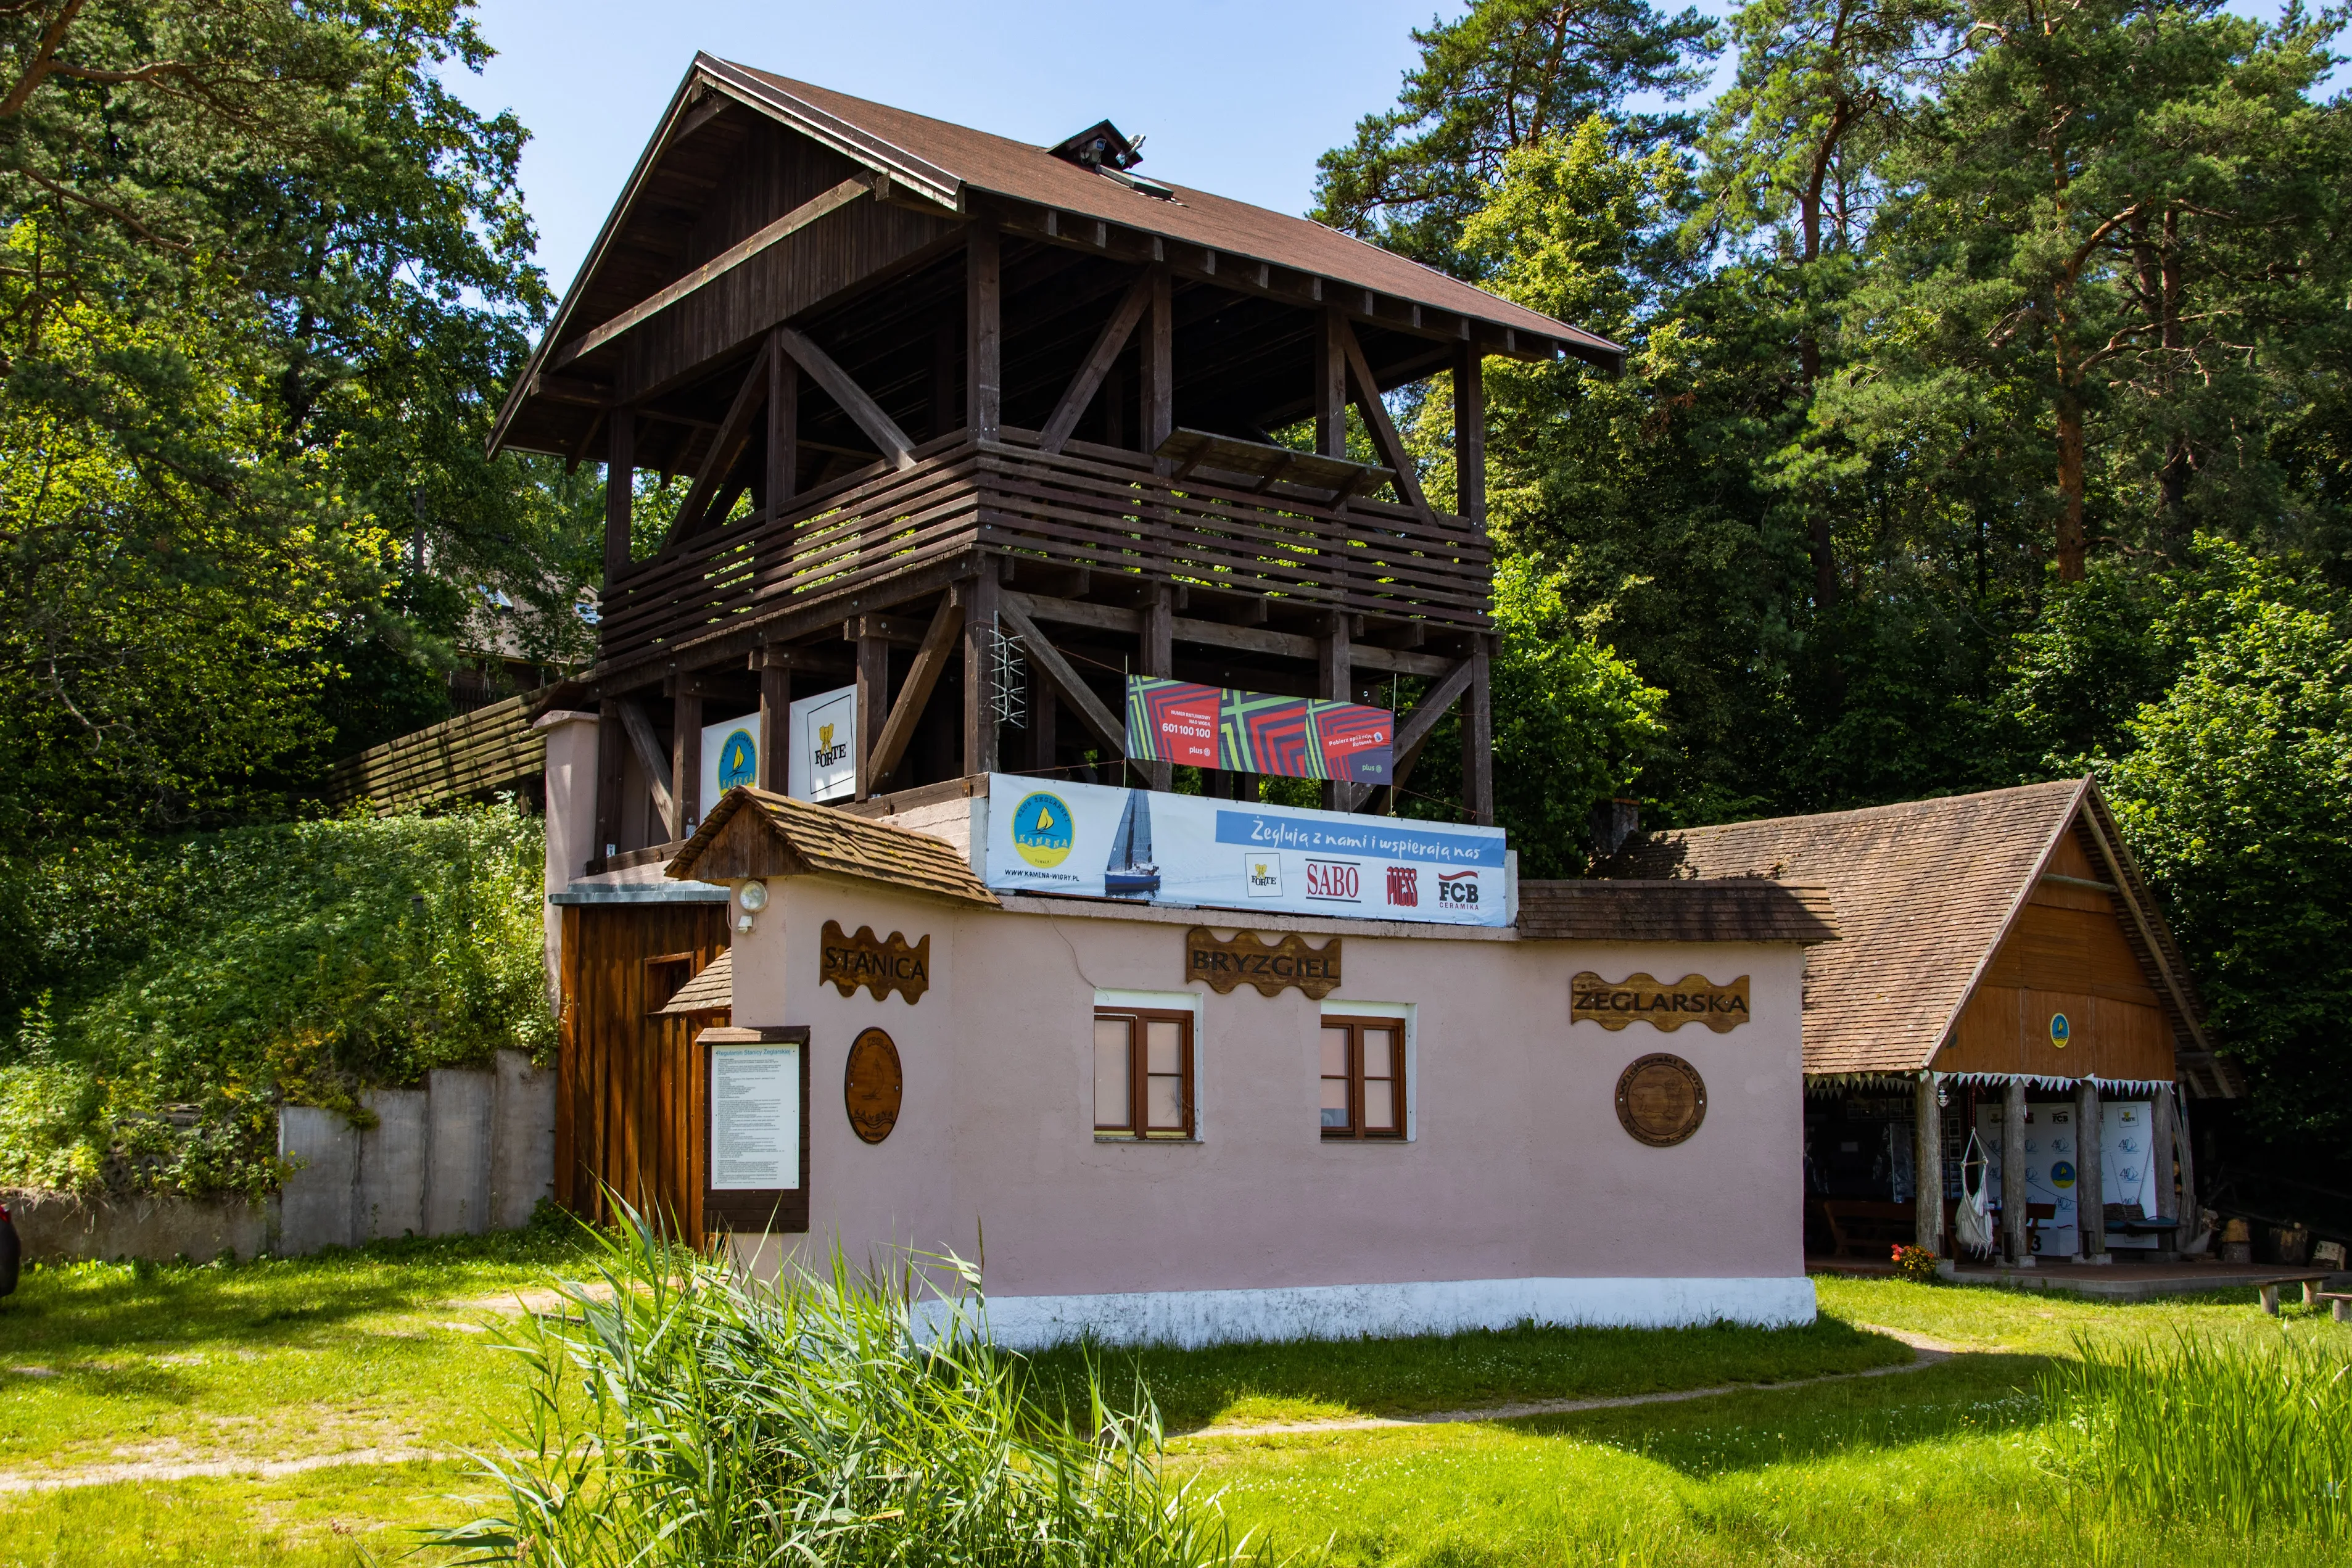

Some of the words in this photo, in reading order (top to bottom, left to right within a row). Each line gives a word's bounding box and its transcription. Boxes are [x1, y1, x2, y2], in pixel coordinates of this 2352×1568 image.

[1186, 712, 1211, 720] RATUNKOWY
[1162, 723, 1178, 733] 601
[1179, 725, 1194, 736] 100
[1195, 728, 1211, 738] 100
[1329, 738, 1348, 746] Pobierz
[815, 743, 846, 767] FORTE
[1018, 801, 1032, 819] KLUB
[1034, 796, 1070, 823] ŻEGLARSKI
[1019, 834, 1068, 849] KAMENA
[1251, 815, 1309, 848] Żeglują
[1313, 833, 1321, 844] z
[1325, 835, 1367, 848] nami
[1371, 835, 1376, 849] i
[1379, 839, 1450, 860] wspierają
[1454, 846, 1480, 859] nas
[1005, 869, 1080, 881] WWW.KAMENA-WIGRY.PL
[1251, 875, 1277, 886] FORTE
[1307, 864, 1359, 898] SABO
[1387, 866, 1418, 907] PRESS
[1438, 881, 1479, 903] FCB
[1439, 902, 1479, 910] CERAMIKA
[825, 946, 927, 981] STANICA
[1193, 949, 1339, 979] BRYZGIEL
[1619, 1056, 1678, 1096] Wigierski
[1683, 1065, 1703, 1097] Park
